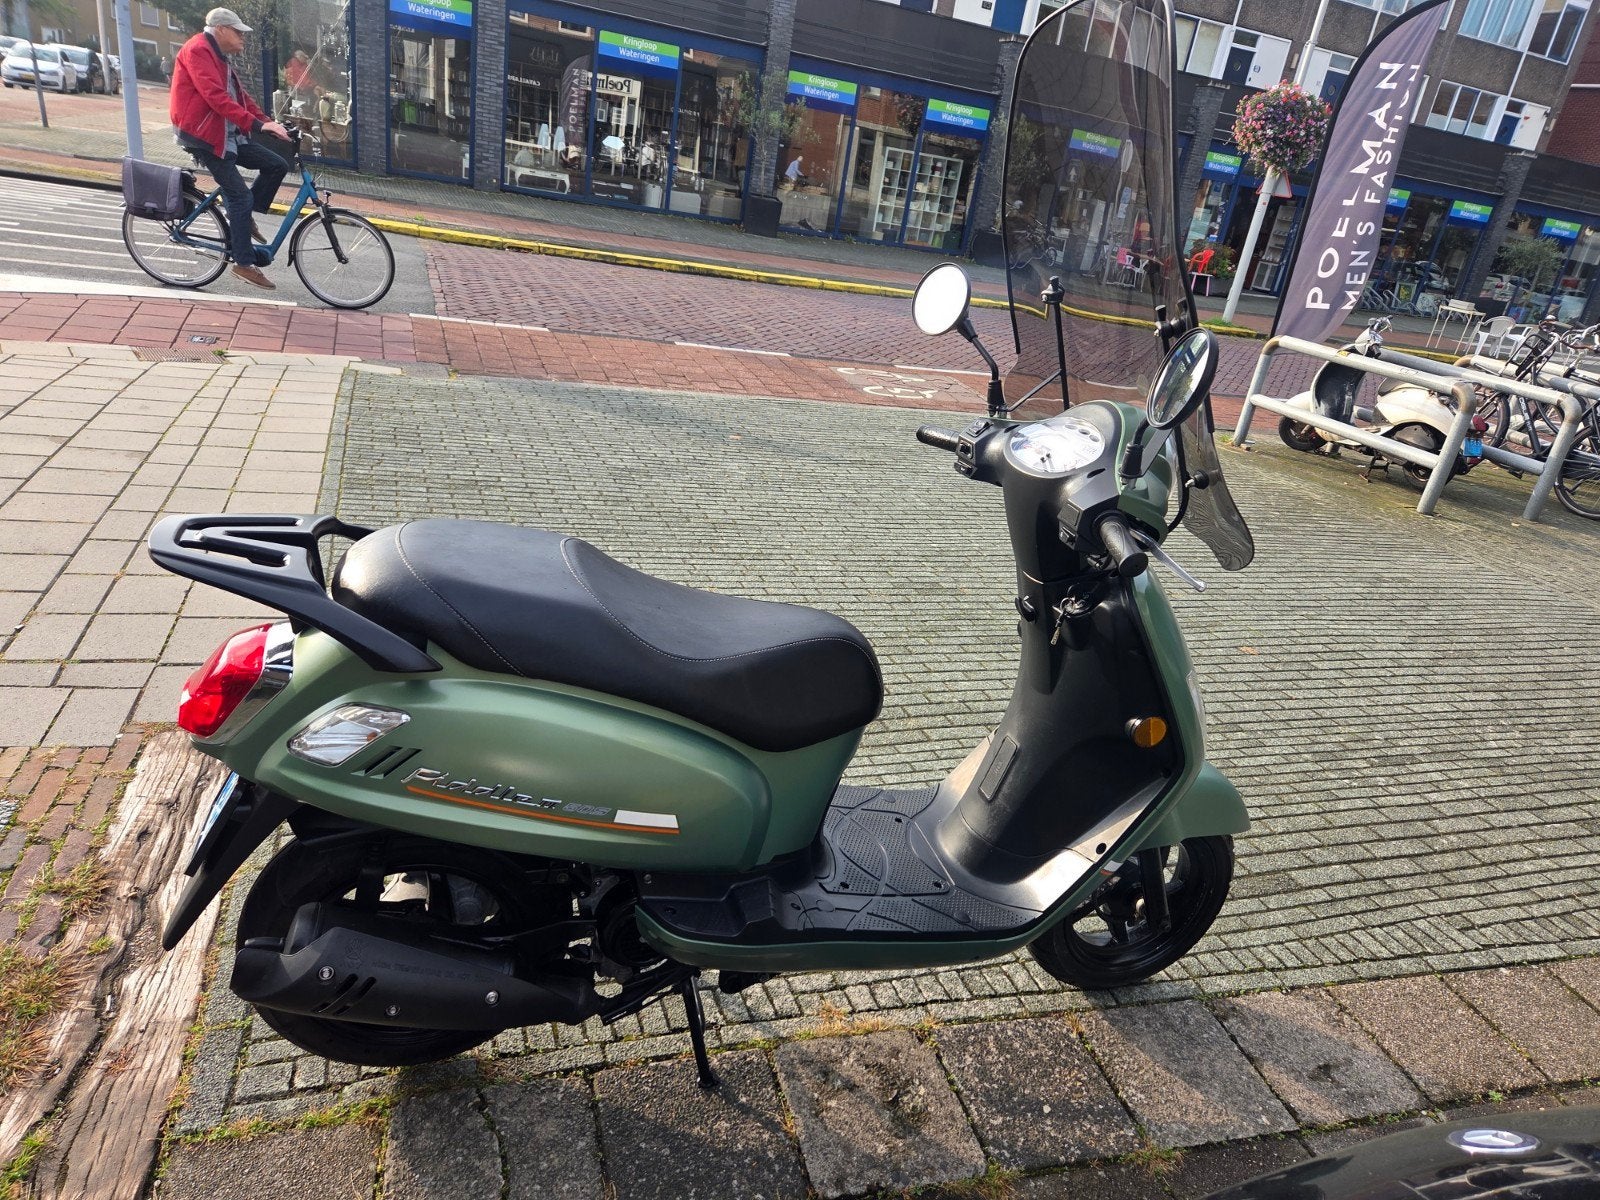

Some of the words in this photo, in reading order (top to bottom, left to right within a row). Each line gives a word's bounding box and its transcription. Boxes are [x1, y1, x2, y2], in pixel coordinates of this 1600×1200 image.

[408, 1, 456, 20] Wateringen
[623, 36, 658, 51] Kringloop
[618, 47, 660, 63] Wateringen
[808, 75, 838, 90] Kringloop
[804, 85, 840, 101] Wateringen
[945, 102, 973, 116] Kringloop
[941, 112, 974, 127] Wateringen
[1305, 62, 1405, 310] POELMAN
[1340, 221, 1375, 310] MEN'S
